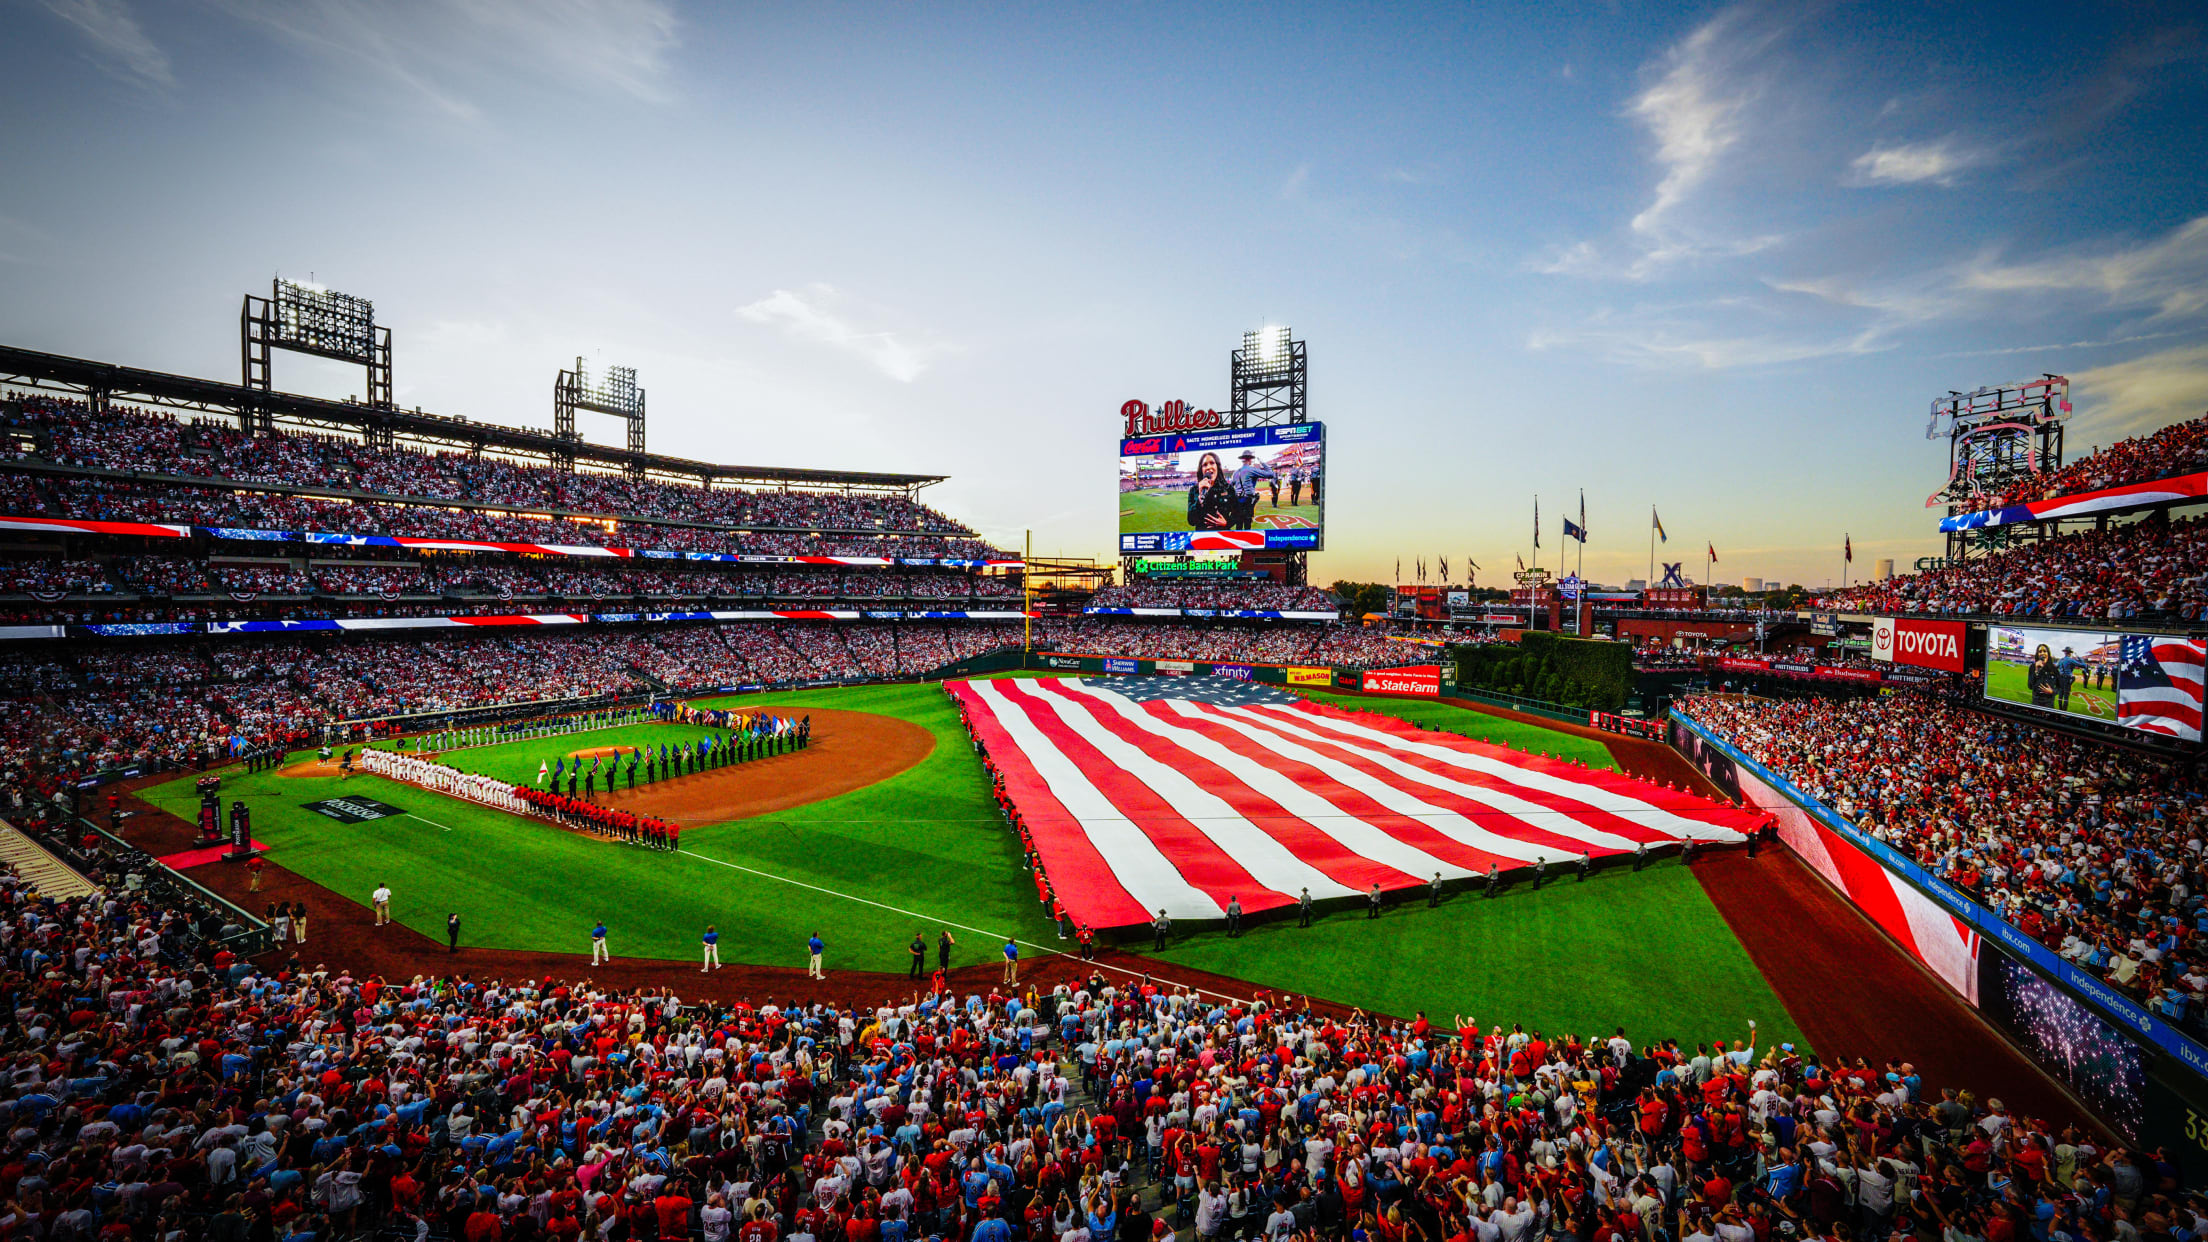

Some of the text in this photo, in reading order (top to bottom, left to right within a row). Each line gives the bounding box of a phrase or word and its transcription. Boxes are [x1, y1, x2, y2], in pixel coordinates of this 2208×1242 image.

[1120, 399, 1220, 436] Phillies
[1124, 438, 1162, 455] Coca-Cola
[1150, 560, 1238, 571] Citizens Bank Park
[1897, 630, 1958, 659] TOYOTA
[1215, 666, 1250, 678] xfinity
[1732, 660, 1761, 668] Budweiser
[1834, 669, 1870, 678] Budweiser
[1338, 676, 1357, 686] GIANT
[1887, 852, 1906, 871] ibx.com
[1927, 877, 1965, 911] Independence
[2001, 928, 2031, 954] ibx.com
[2071, 971, 2137, 1022] Independence
[1767, 1100, 1777, 1111] 26
[767, 1145, 776, 1157] 3
